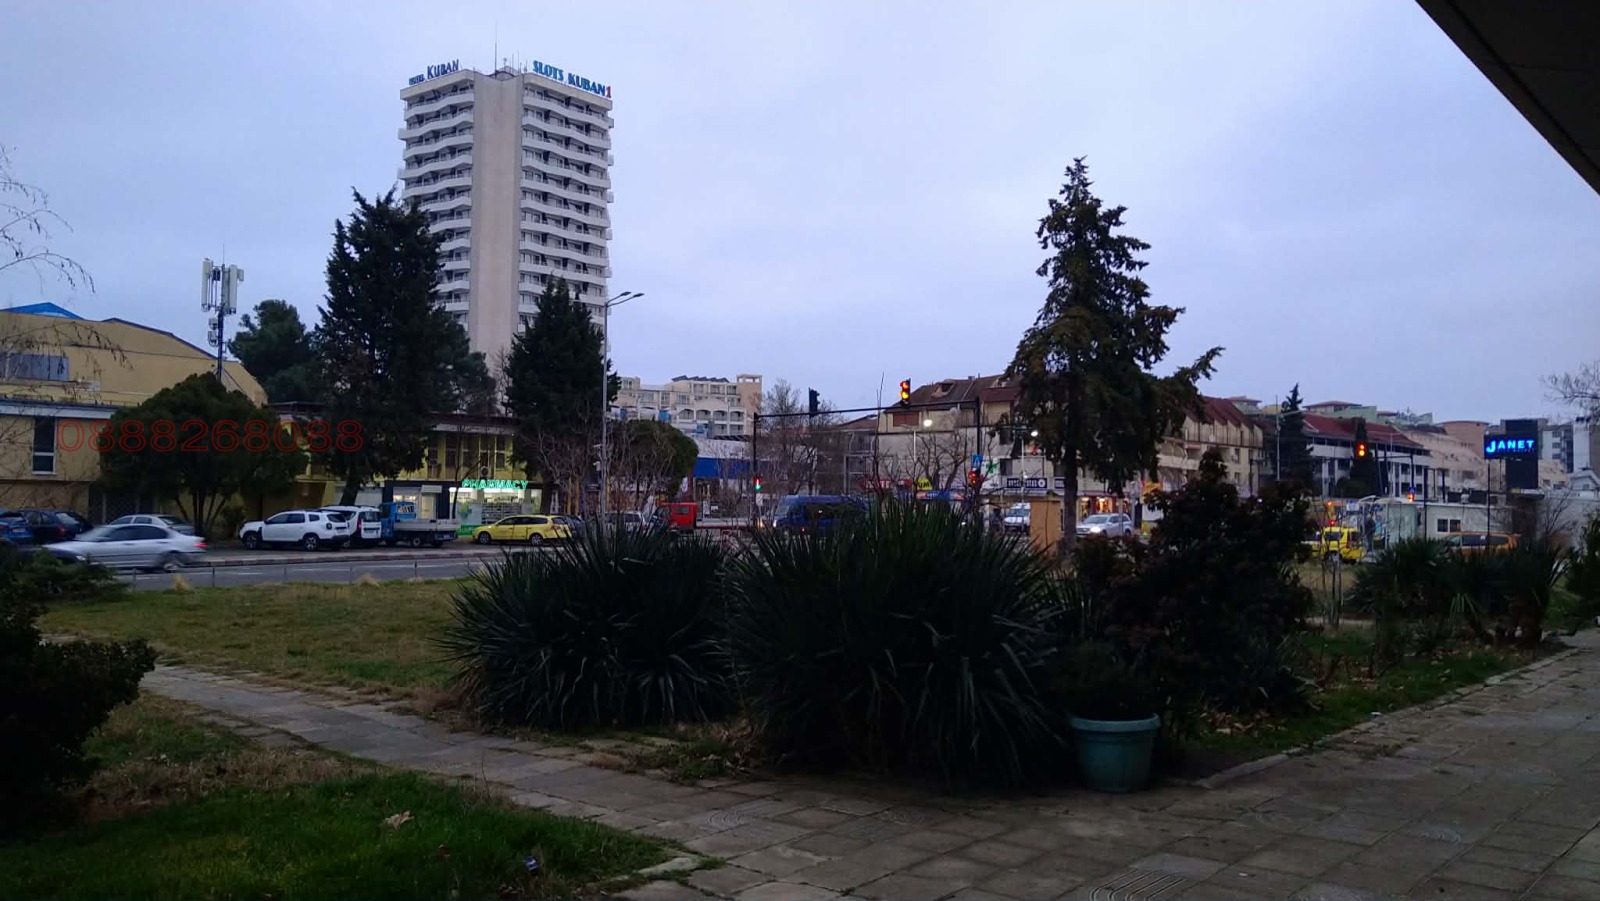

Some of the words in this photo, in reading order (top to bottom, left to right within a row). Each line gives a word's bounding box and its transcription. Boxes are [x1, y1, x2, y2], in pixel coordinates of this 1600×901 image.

[427, 58, 459, 80] KUBAN
[532, 60, 564, 81] SLOTS
[1485, 439, 1535, 453] JANET
[462, 479, 529, 491] PHARMACY
